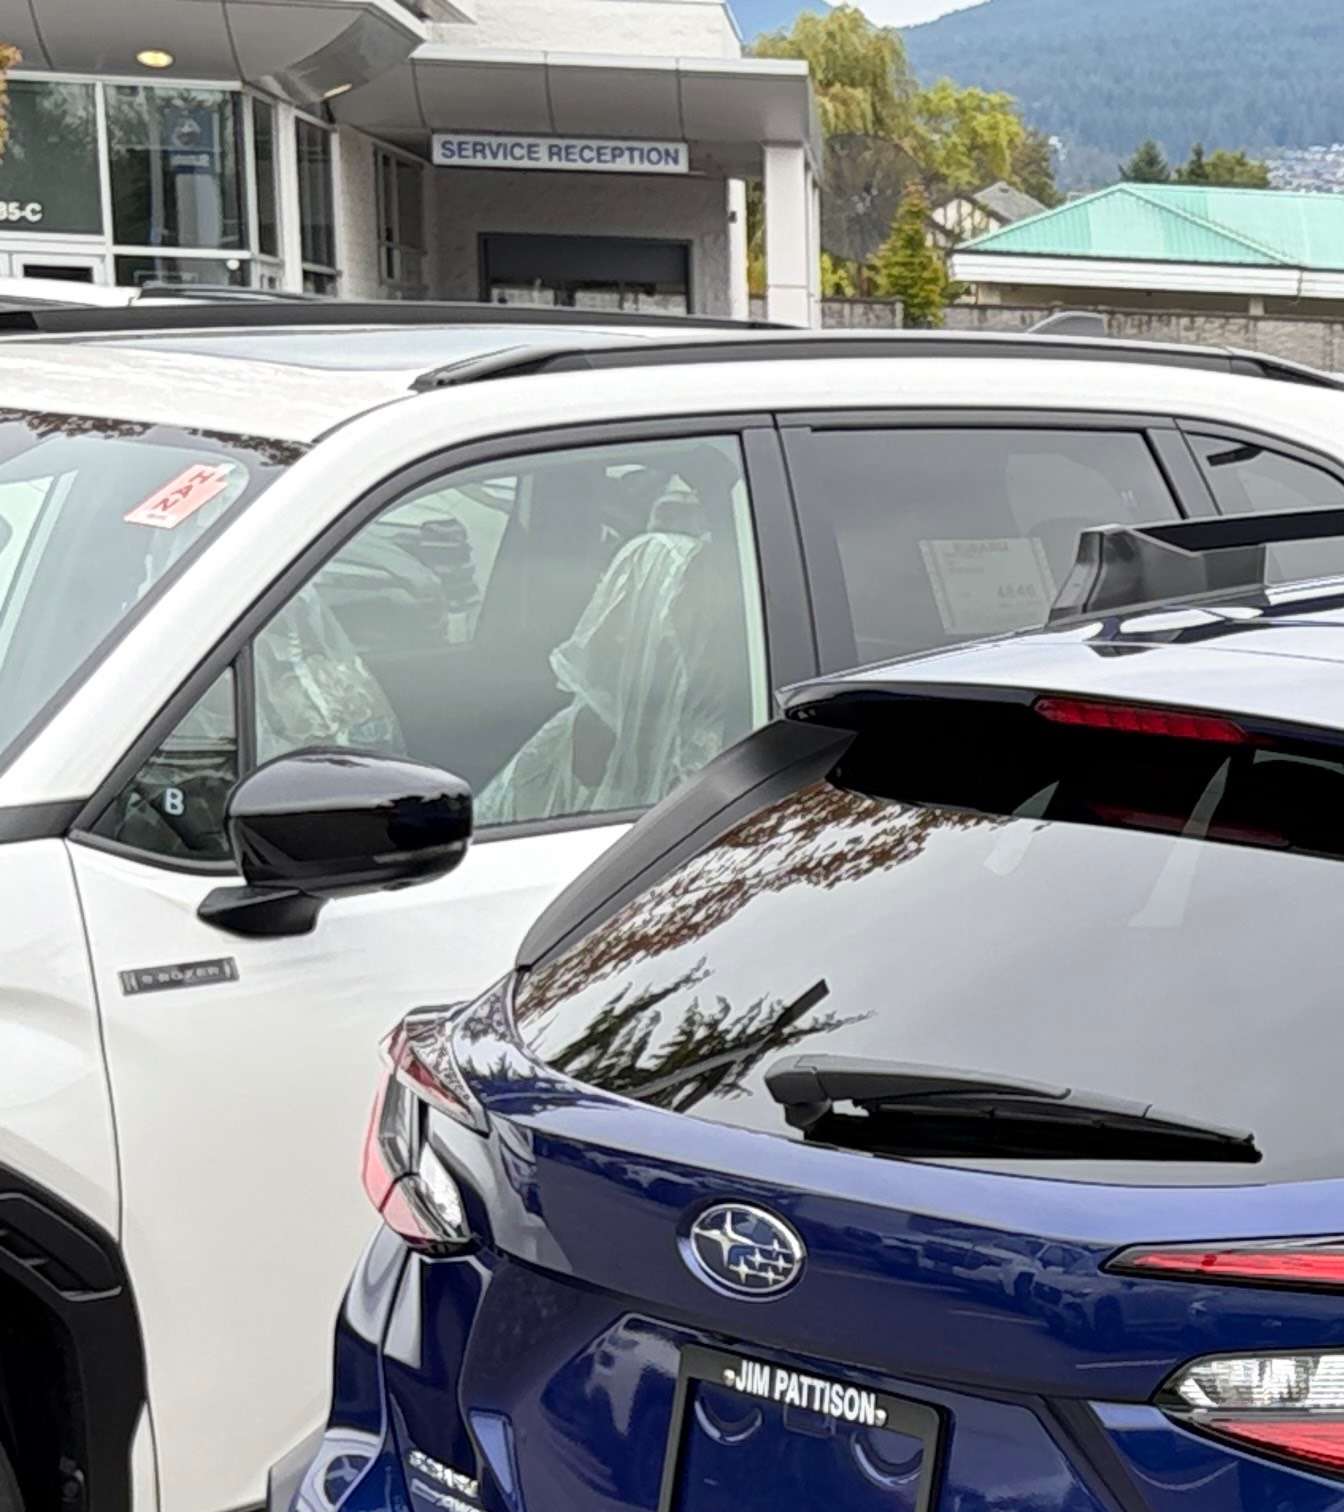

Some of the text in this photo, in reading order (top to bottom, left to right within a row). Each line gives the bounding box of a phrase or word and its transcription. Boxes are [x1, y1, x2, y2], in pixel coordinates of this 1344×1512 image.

[440, 140, 680, 166] SERVICE RECEPTION
[735, 1359, 877, 1426] JIM PATTISON
